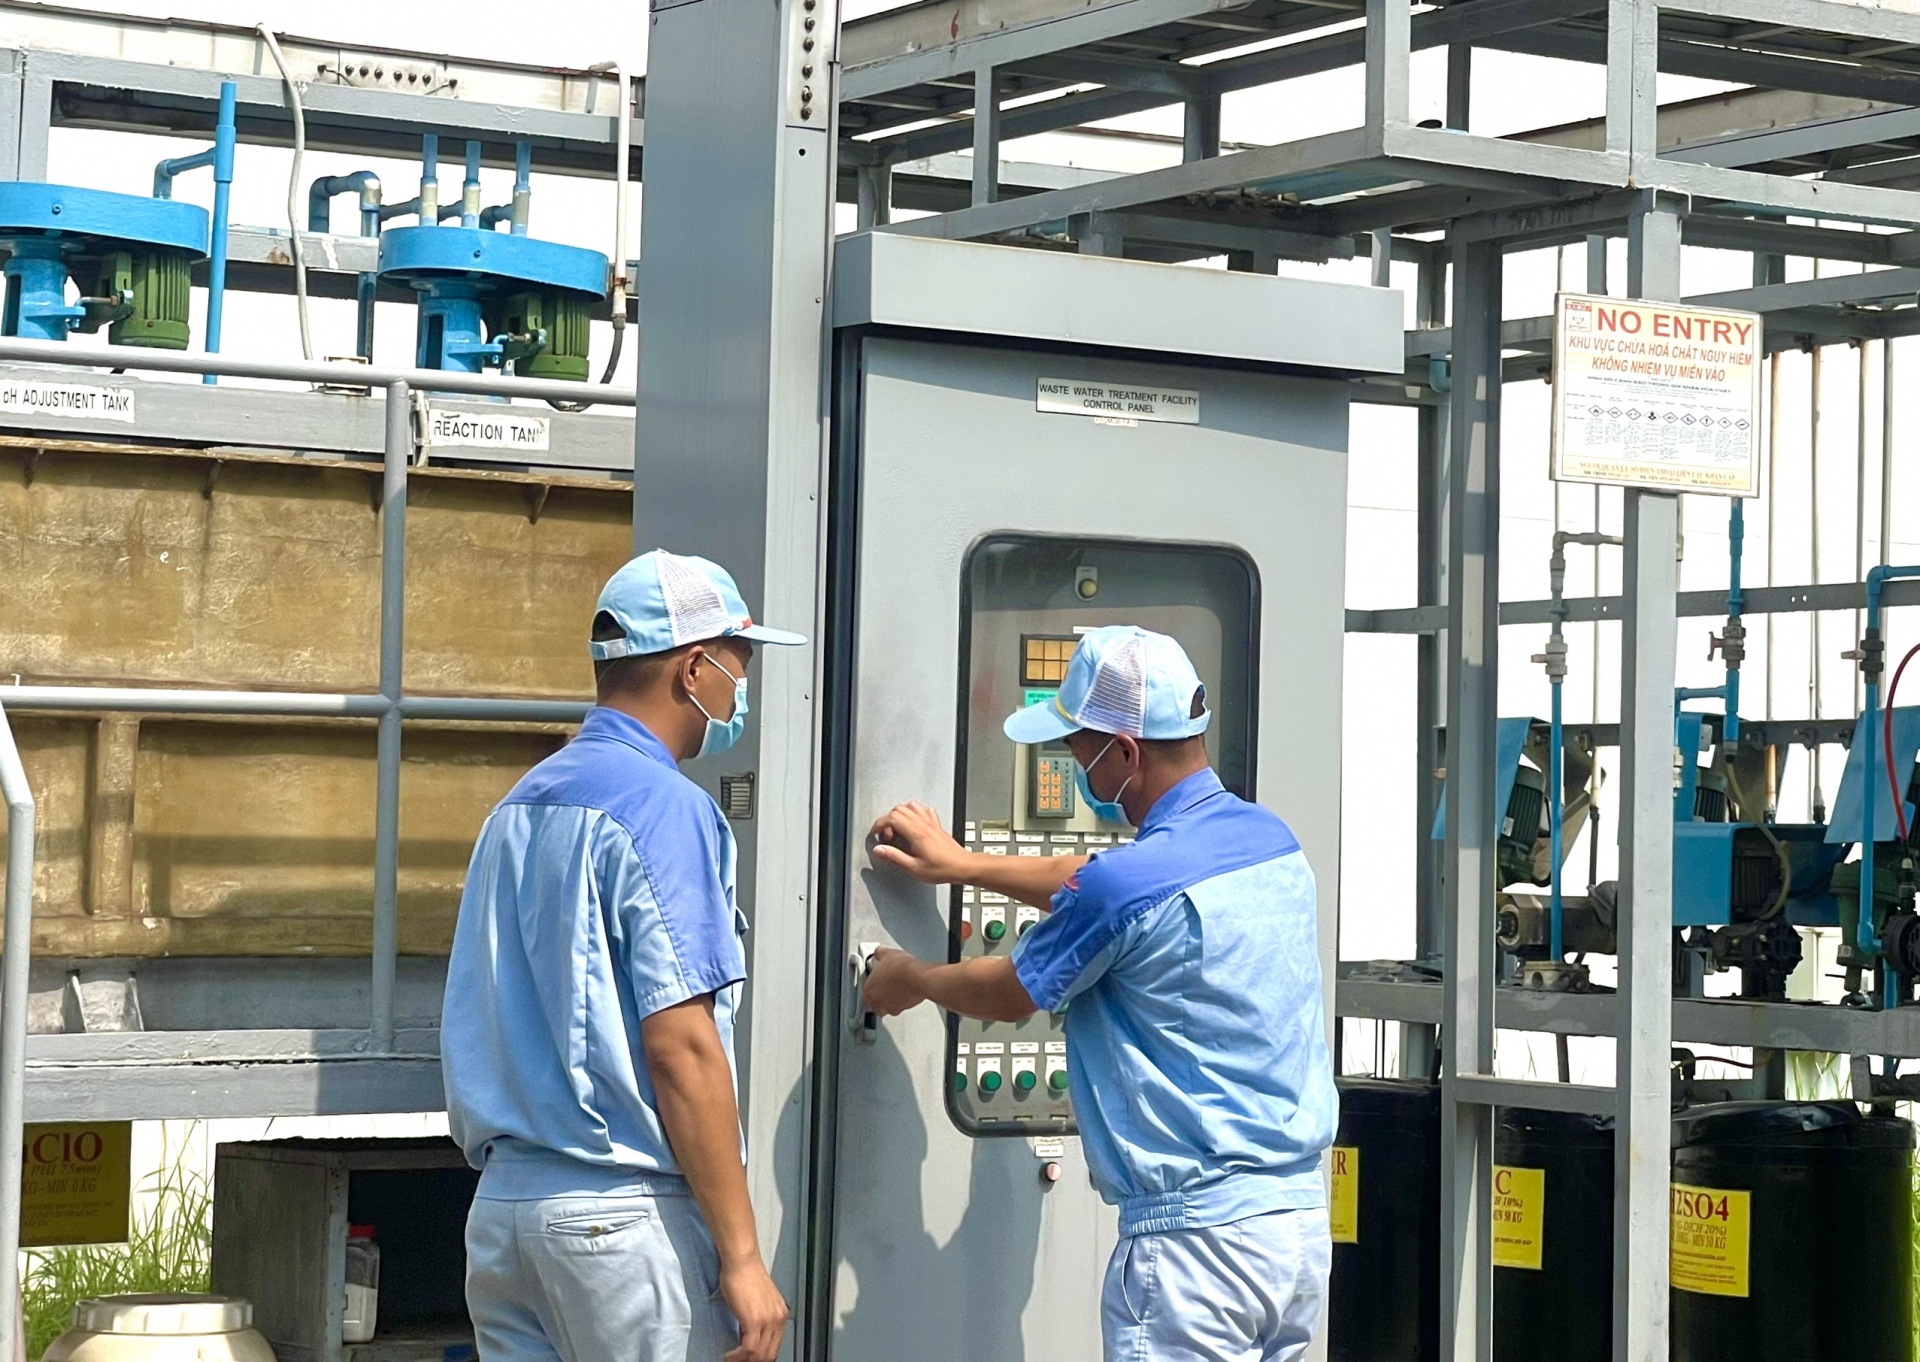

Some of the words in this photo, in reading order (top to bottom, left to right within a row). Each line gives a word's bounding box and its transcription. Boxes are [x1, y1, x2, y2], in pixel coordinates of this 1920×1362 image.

[1598, 307, 1642, 334] NO
[1653, 313, 1753, 346] ENTRY
[1569, 335, 1591, 349] KHU
[1700, 348, 1727, 363] NGUY
[22, 389, 96, 409] ADJUSTMENT
[102, 394, 129, 412] TANK
[1039, 384, 1069, 395] WASTE
[1073, 387, 1104, 398] WATER
[1108, 389, 1158, 403] TREATMENT
[1162, 394, 1198, 406] FACILITY
[1083, 399, 1124, 411] CONTROL
[1128, 402, 1155, 414] PANEL
[433, 420, 503, 441] REACTION
[1714, 1236, 1727, 1249] KG
